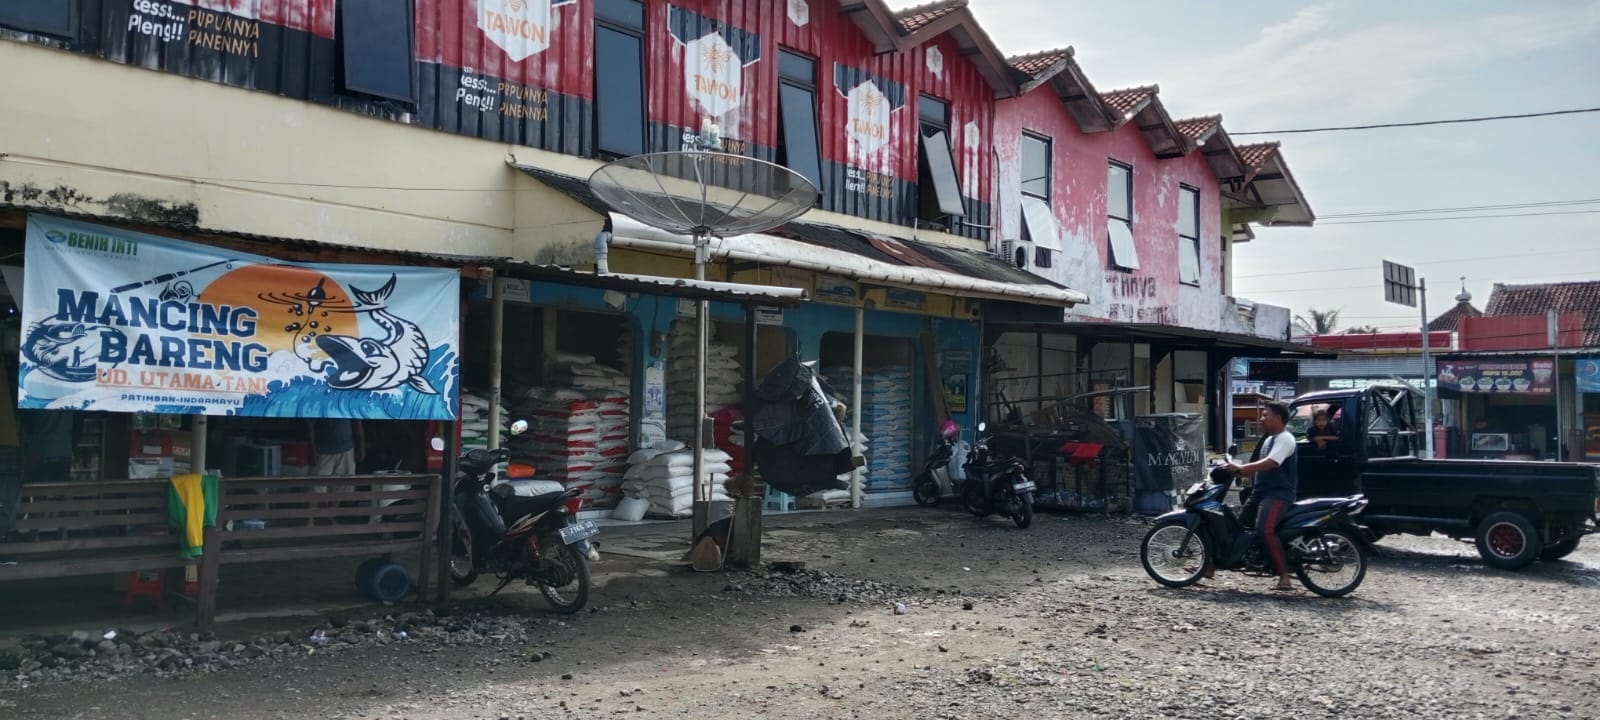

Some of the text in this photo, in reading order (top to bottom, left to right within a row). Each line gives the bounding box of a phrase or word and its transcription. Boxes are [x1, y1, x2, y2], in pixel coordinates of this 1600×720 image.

[128, 14, 182, 42] Pleng!!
[188, 9, 259, 38] PUPUKNYA
[486, 10, 545, 43] TAWON
[694, 74, 737, 103] TAWON
[68, 231, 109, 252] BENIH
[111, 236, 138, 256] INTI
[55, 288, 257, 338] MANCING
[100, 331, 268, 373] BARENG
[97, 368, 267, 394] UD. UTAMA TANI
[121, 393, 240, 406] PATIMBAN-INDRAMAYU
